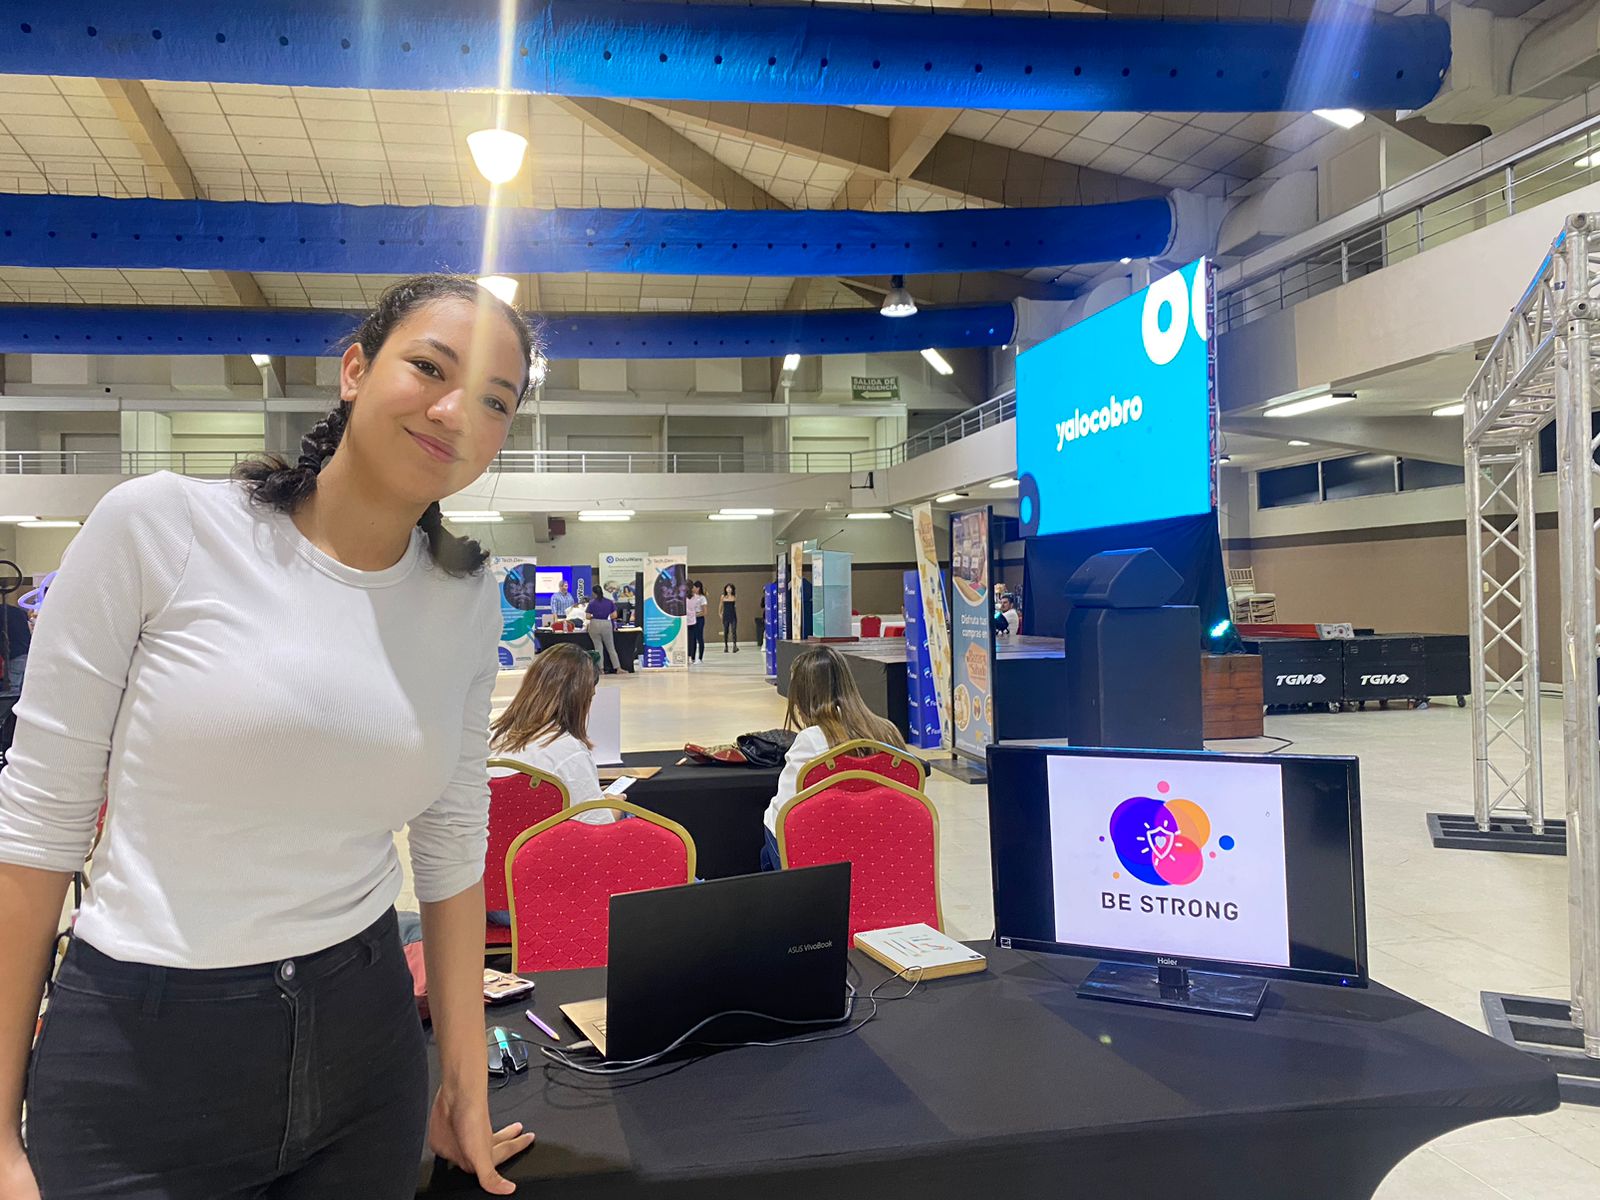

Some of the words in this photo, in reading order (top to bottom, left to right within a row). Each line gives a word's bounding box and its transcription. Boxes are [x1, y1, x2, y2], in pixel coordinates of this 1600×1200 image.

[1055, 394, 1143, 452] yalocobro
[1276, 673, 1313, 686] TGM
[1360, 673, 1397, 686] TGM
[1101, 891, 1132, 911] BE
[1140, 895, 1239, 921] STRONG
[788, 944, 804, 954] ASUS
[1157, 957, 1178, 966] Haier
